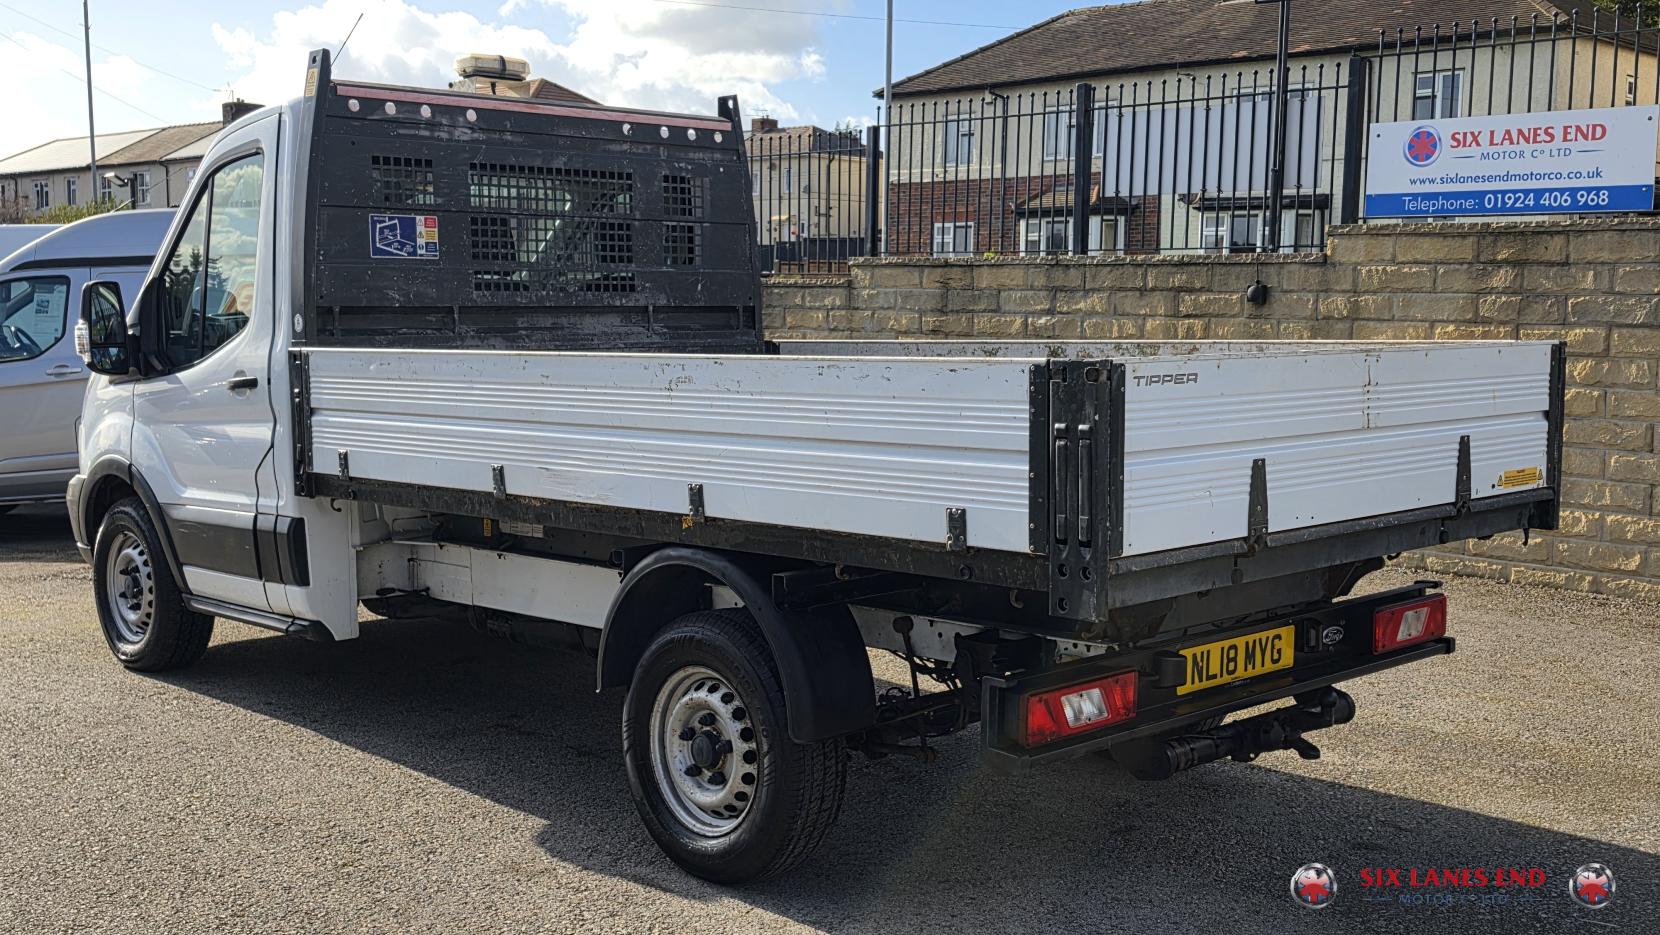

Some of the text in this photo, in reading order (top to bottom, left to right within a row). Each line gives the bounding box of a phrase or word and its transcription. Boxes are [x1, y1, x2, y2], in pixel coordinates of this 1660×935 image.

[1450, 123, 1607, 149] SIX LANES END
[1480, 150, 1526, 161] MOTOR
[1549, 147, 1572, 158] LTD
[1409, 167, 1603, 186] www.sixlanesendmotorco.co.uk
[1402, 190, 1609, 212] Telephone: 01924 406 968
[1133, 373, 1198, 387] TIPPER
[1191, 633, 1282, 685] NL18 MYG
